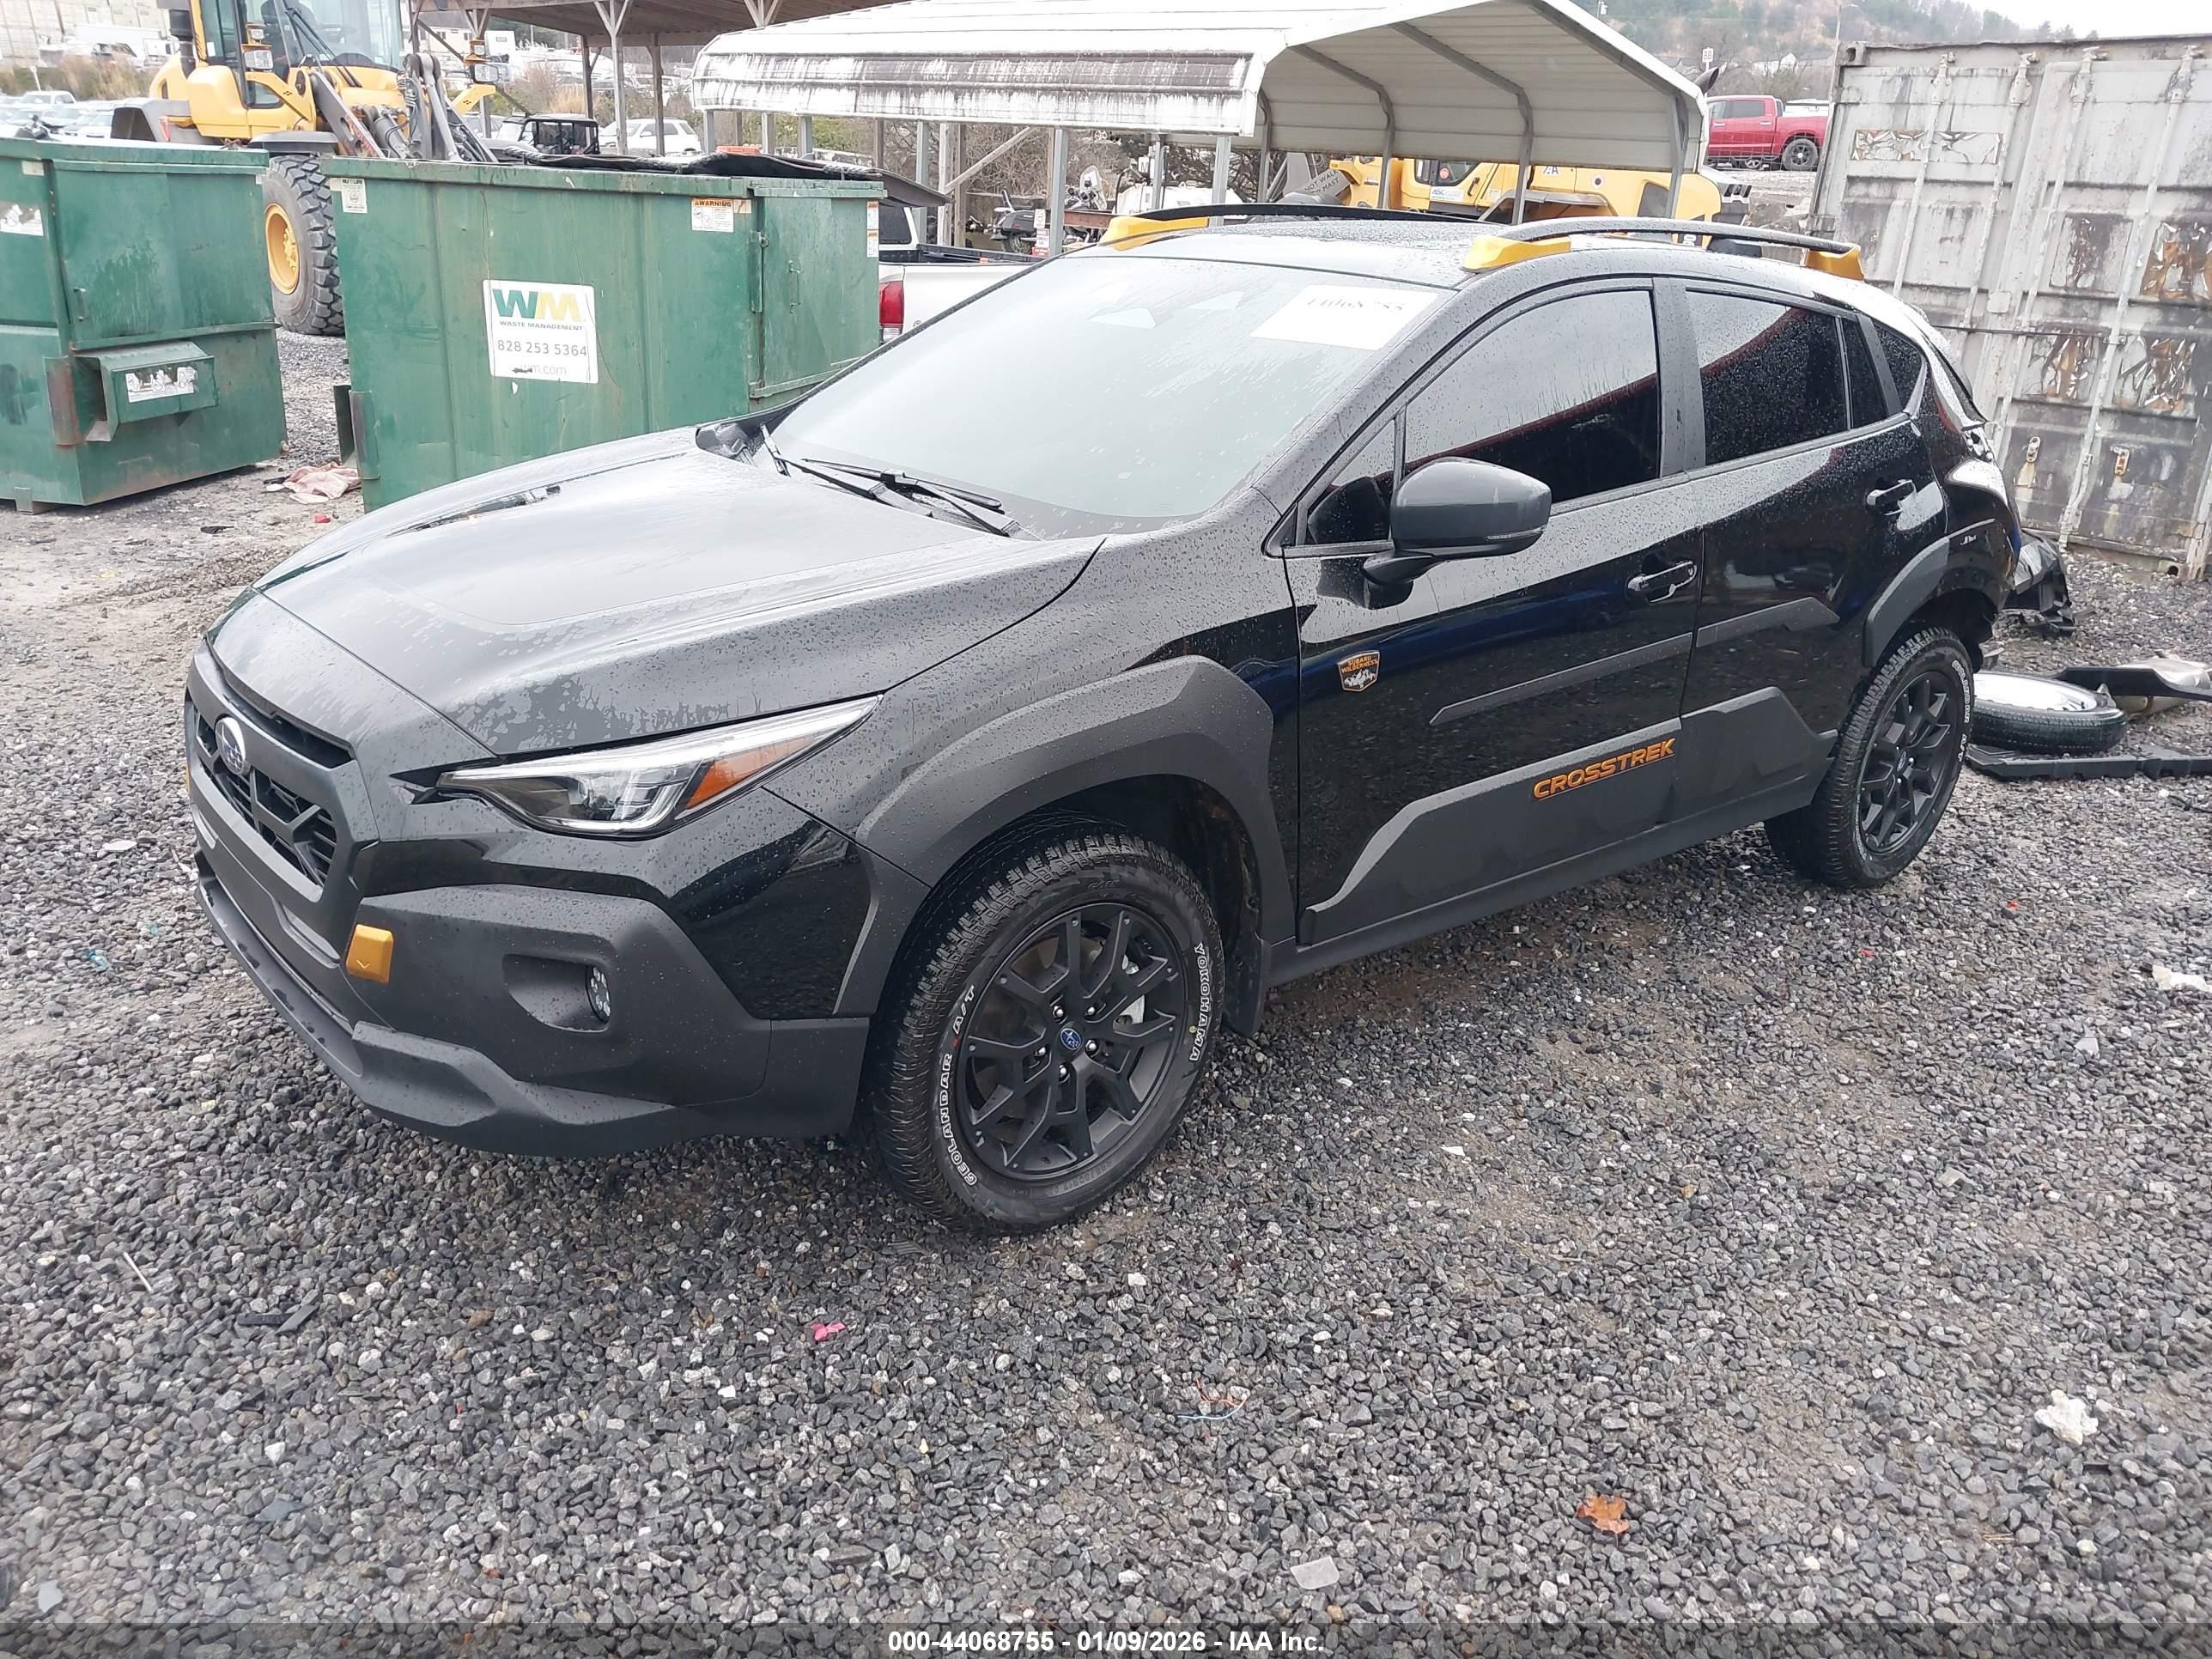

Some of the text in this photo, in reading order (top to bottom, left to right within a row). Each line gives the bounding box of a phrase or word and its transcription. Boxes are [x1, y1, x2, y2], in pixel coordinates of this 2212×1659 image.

[1322, 177, 1340, 191] MAST
[491, 288, 582, 323] WM
[499, 319, 585, 331] WASTE MANAGEMENT
[497, 339, 587, 357] 828 253 5364
[1340, 658, 1378, 673] WILDERNESS
[1347, 655, 1372, 666] SUBARU
[1533, 738, 1676, 799] CROSSTREK
[1188, 941, 1211, 1061] YOKOHAMA
[939, 984, 978, 1186] GEOLANDAR A/T
